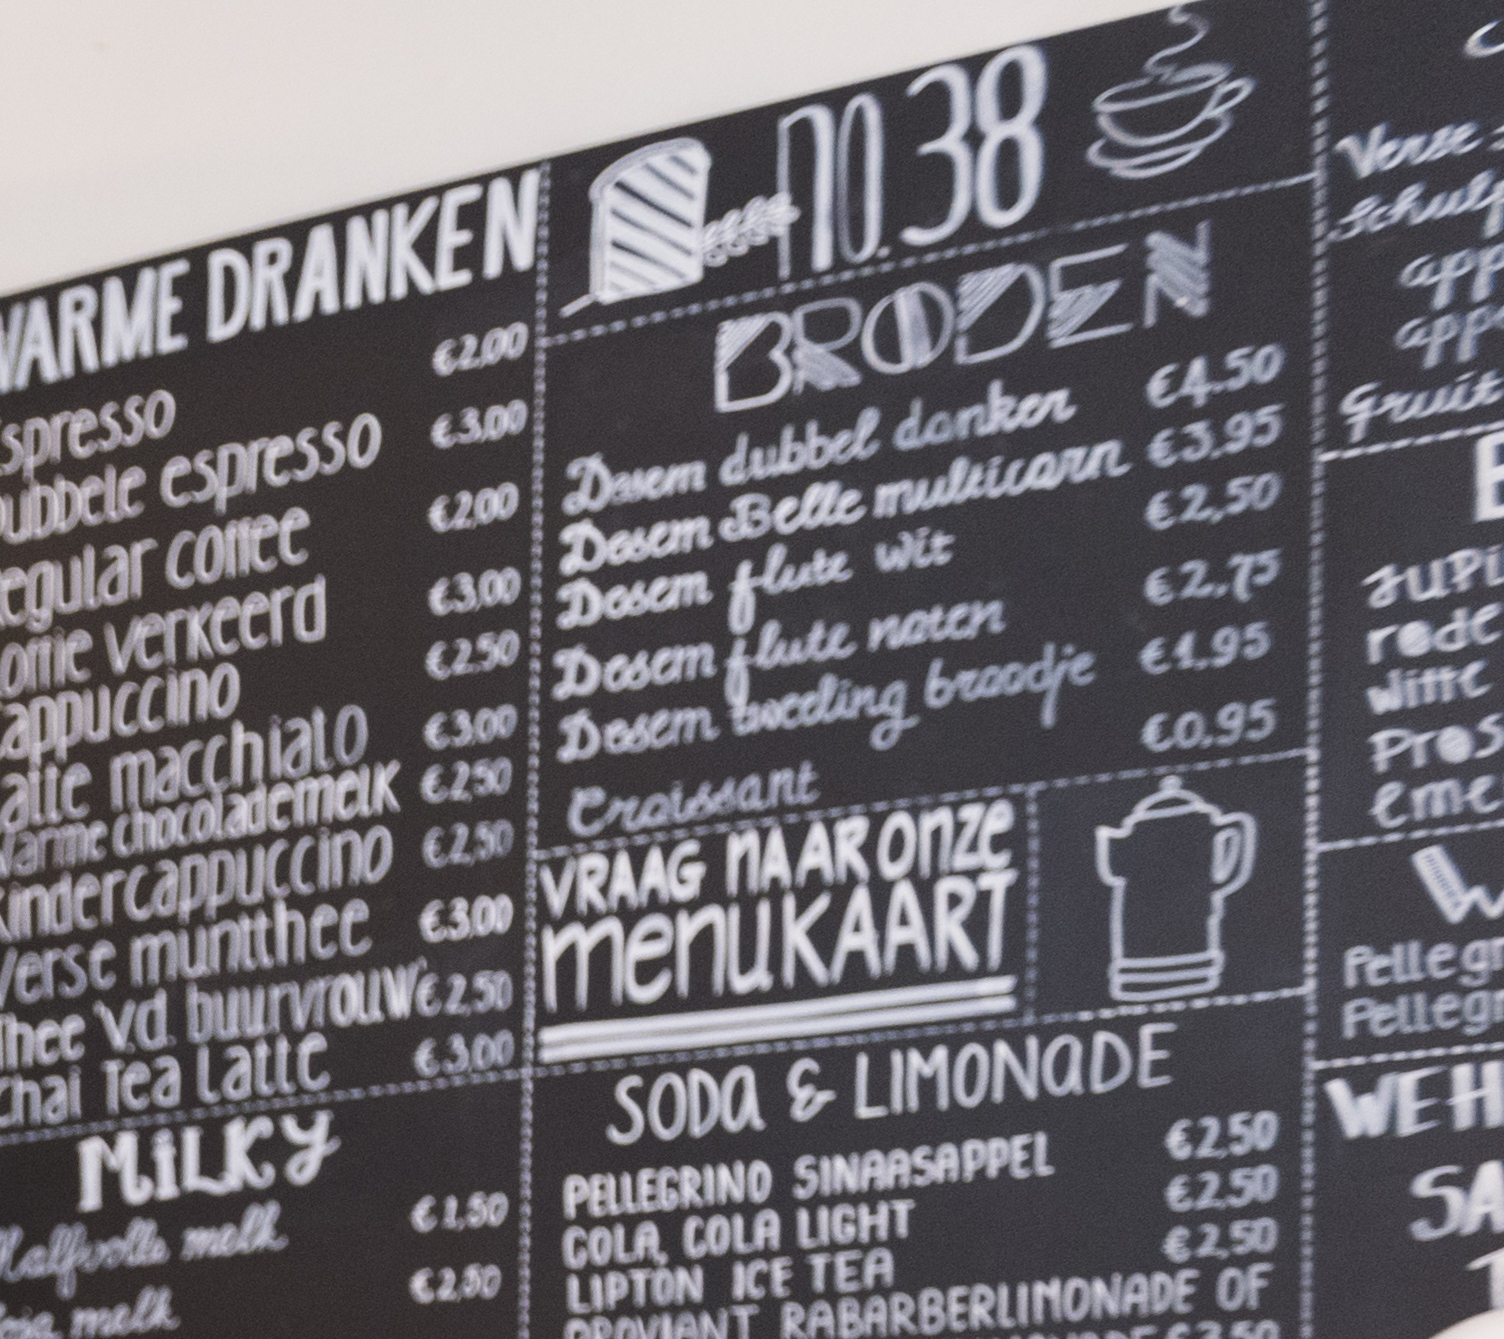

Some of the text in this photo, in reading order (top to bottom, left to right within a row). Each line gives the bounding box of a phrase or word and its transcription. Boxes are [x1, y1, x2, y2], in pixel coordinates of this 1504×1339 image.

[900, 43, 1047, 247] 38
[206, 169, 541, 343] DRANKEN
[161, 413, 381, 515] espresso
[719, 406, 881, 486] dubbel
[923, 641, 1096, 728] broodje
[110, 703, 369, 812] macchiato
[112, 759, 401, 858] chocolademelk
[539, 841, 706, 921] VRAAG
[102, 1055, 182, 1115] Tea
[196, 1032, 330, 1103] Latte
[561, 1159, 772, 1221] PELLEGRINO
[792, 1131, 1054, 1200] SINAASAPPEL
[682, 1208, 782, 1260] COLA
[795, 1198, 916, 1249] LIGHT
[566, 1263, 703, 1316] LIPTON
[731, 1256, 793, 1302] ICE
[806, 1246, 895, 1294] TEA
[1216, 1262, 1275, 1311] OF
